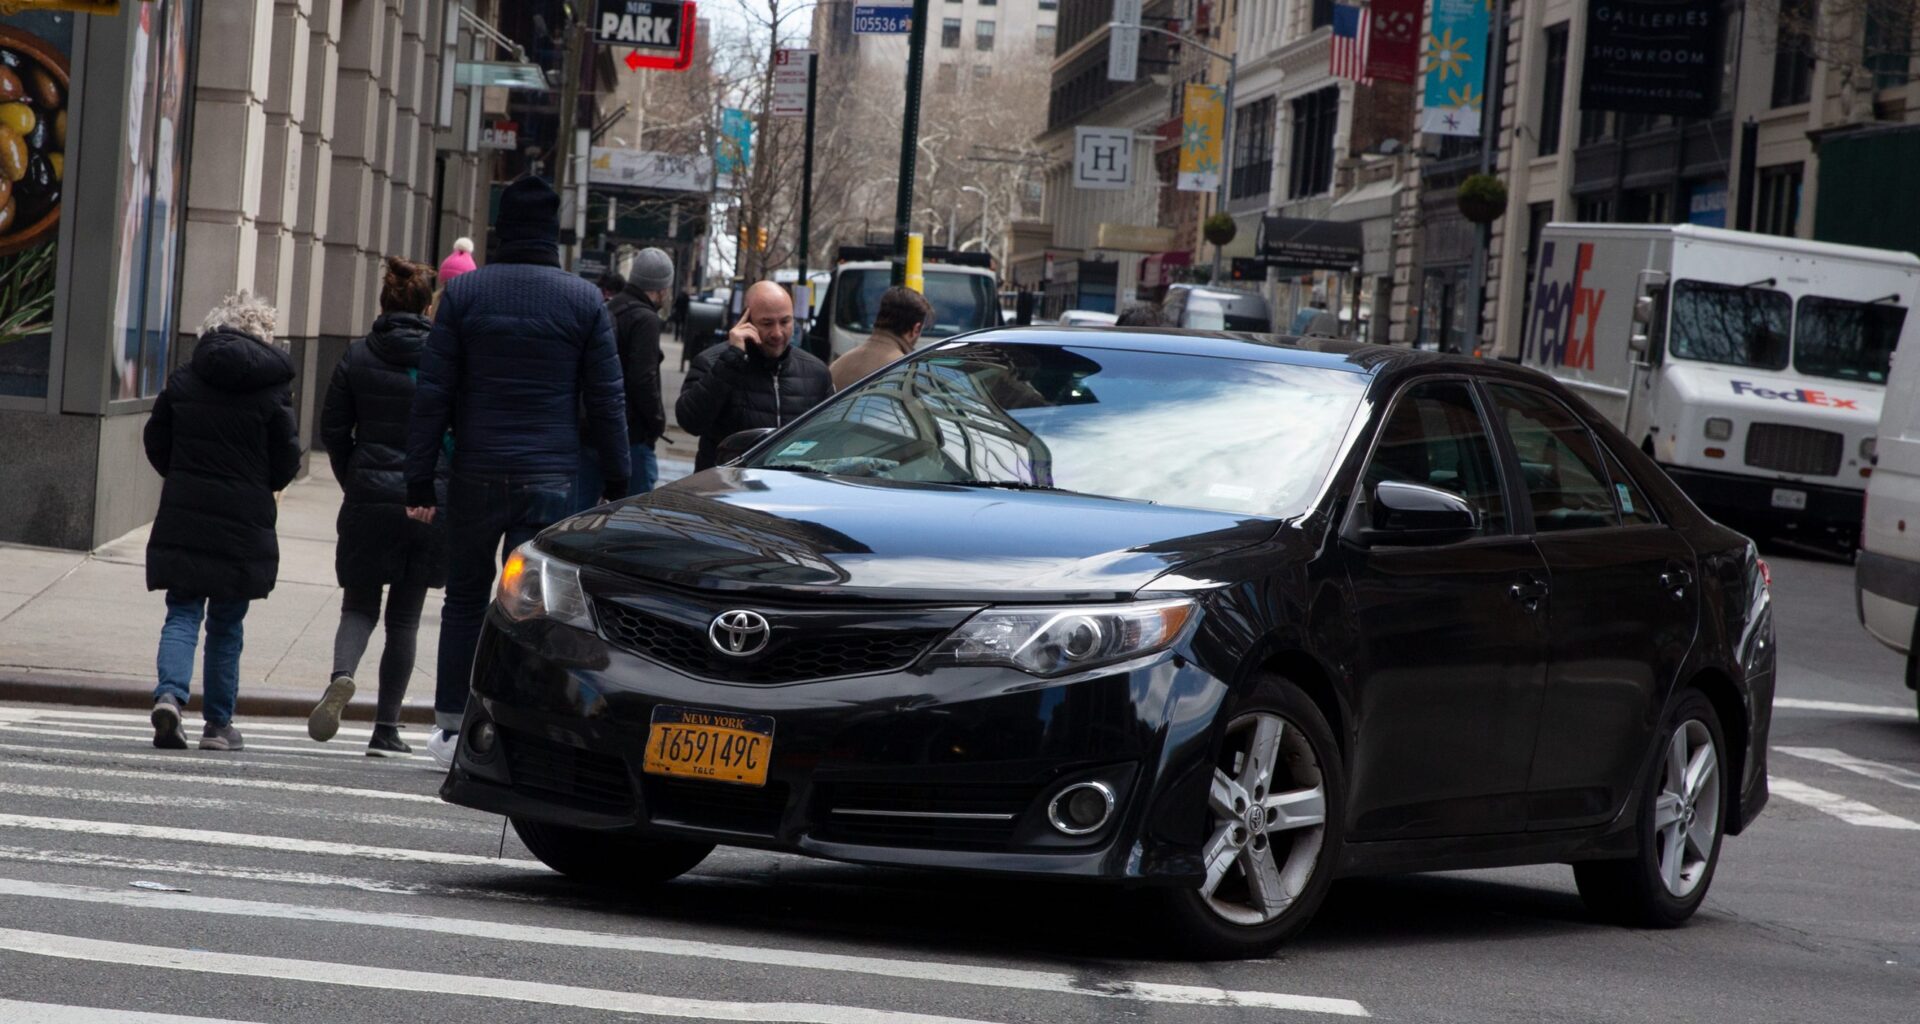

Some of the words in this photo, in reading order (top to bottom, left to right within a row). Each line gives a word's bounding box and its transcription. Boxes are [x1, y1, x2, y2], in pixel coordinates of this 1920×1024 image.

[601, 12, 673, 44] PARK
[856, 17, 897, 32] 105536
[1596, 6, 1709, 28] GALLERIES
[1593, 45, 1705, 64] SHOWROOM
[1092, 145, 1117, 172] H
[1527, 241, 1606, 371] FedEx
[1730, 380, 1858, 410] FedEx
[682, 712, 711, 725] NEW
[713, 715, 746, 729] YORK
[659, 727, 760, 770] T659149C
